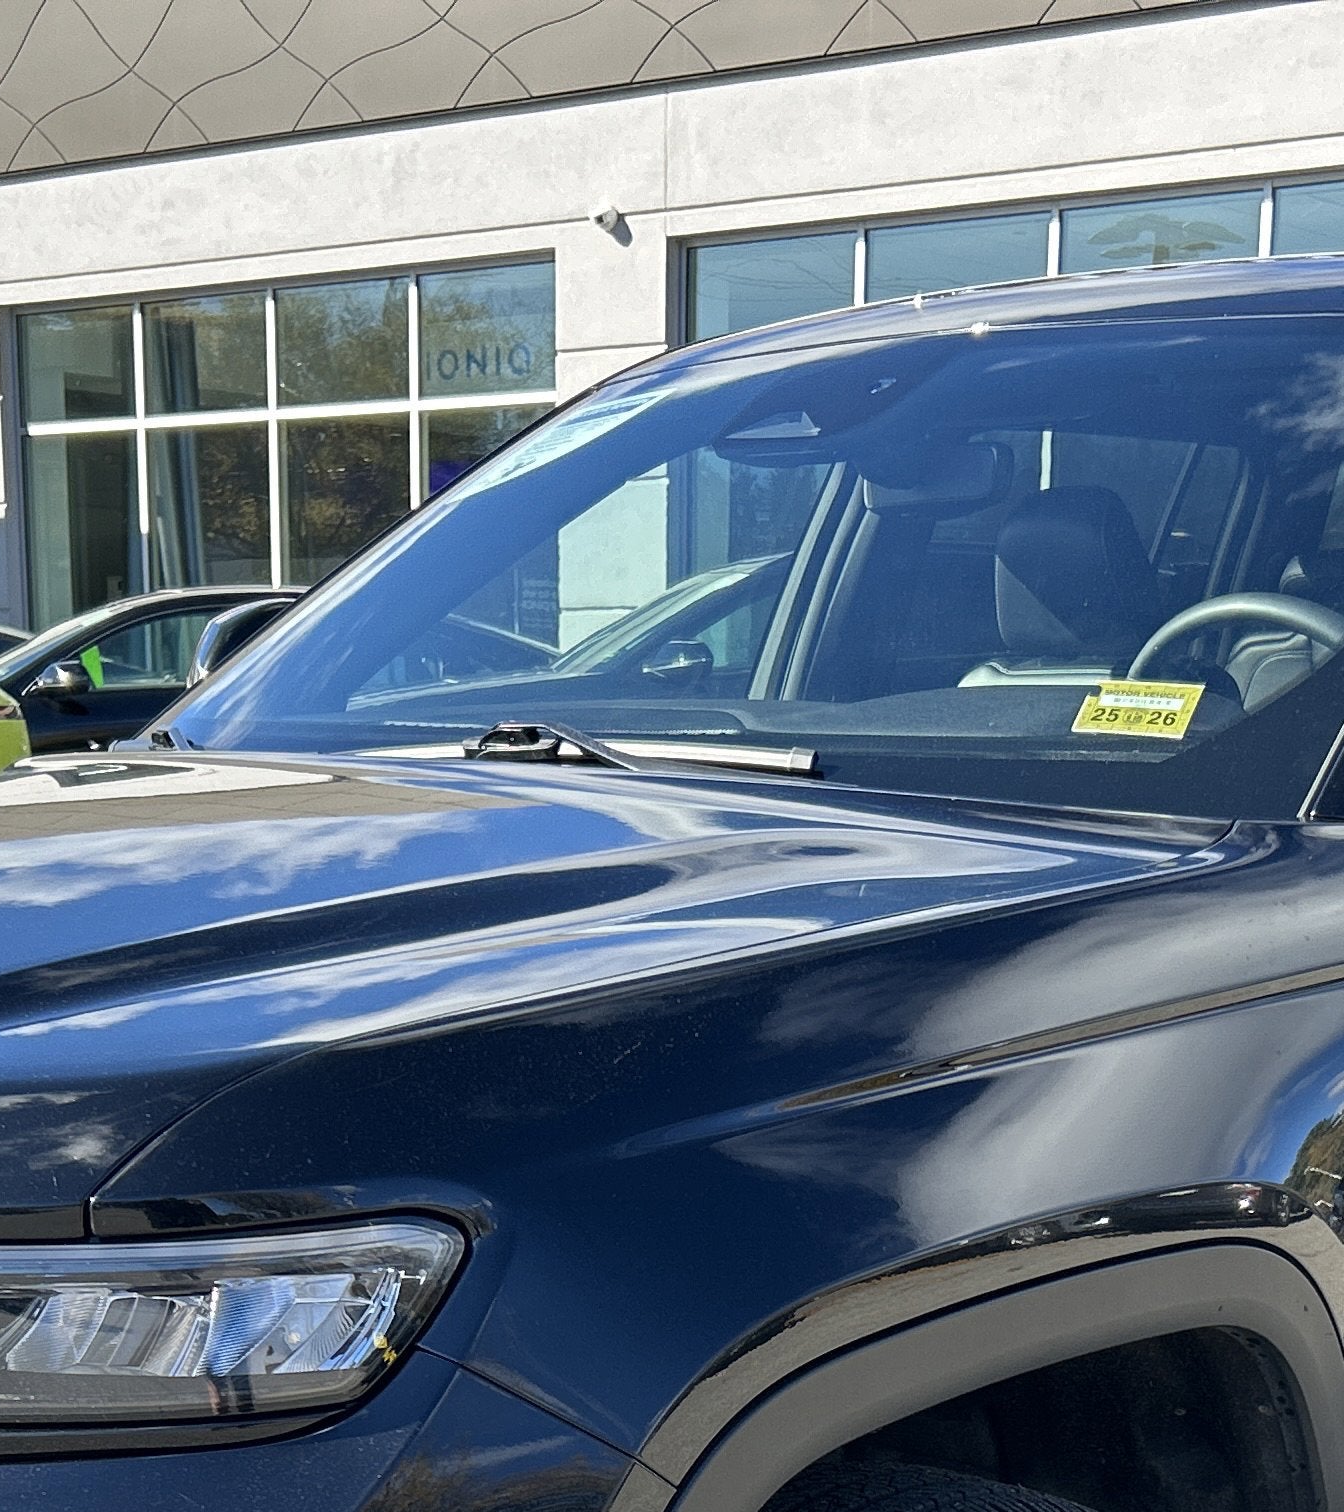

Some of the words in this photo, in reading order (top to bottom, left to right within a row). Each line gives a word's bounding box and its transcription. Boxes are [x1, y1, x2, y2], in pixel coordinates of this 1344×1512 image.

[425, 342, 531, 380] IONIQ
[1090, 708, 1122, 722] 25
[1146, 711, 1178, 726] 26
